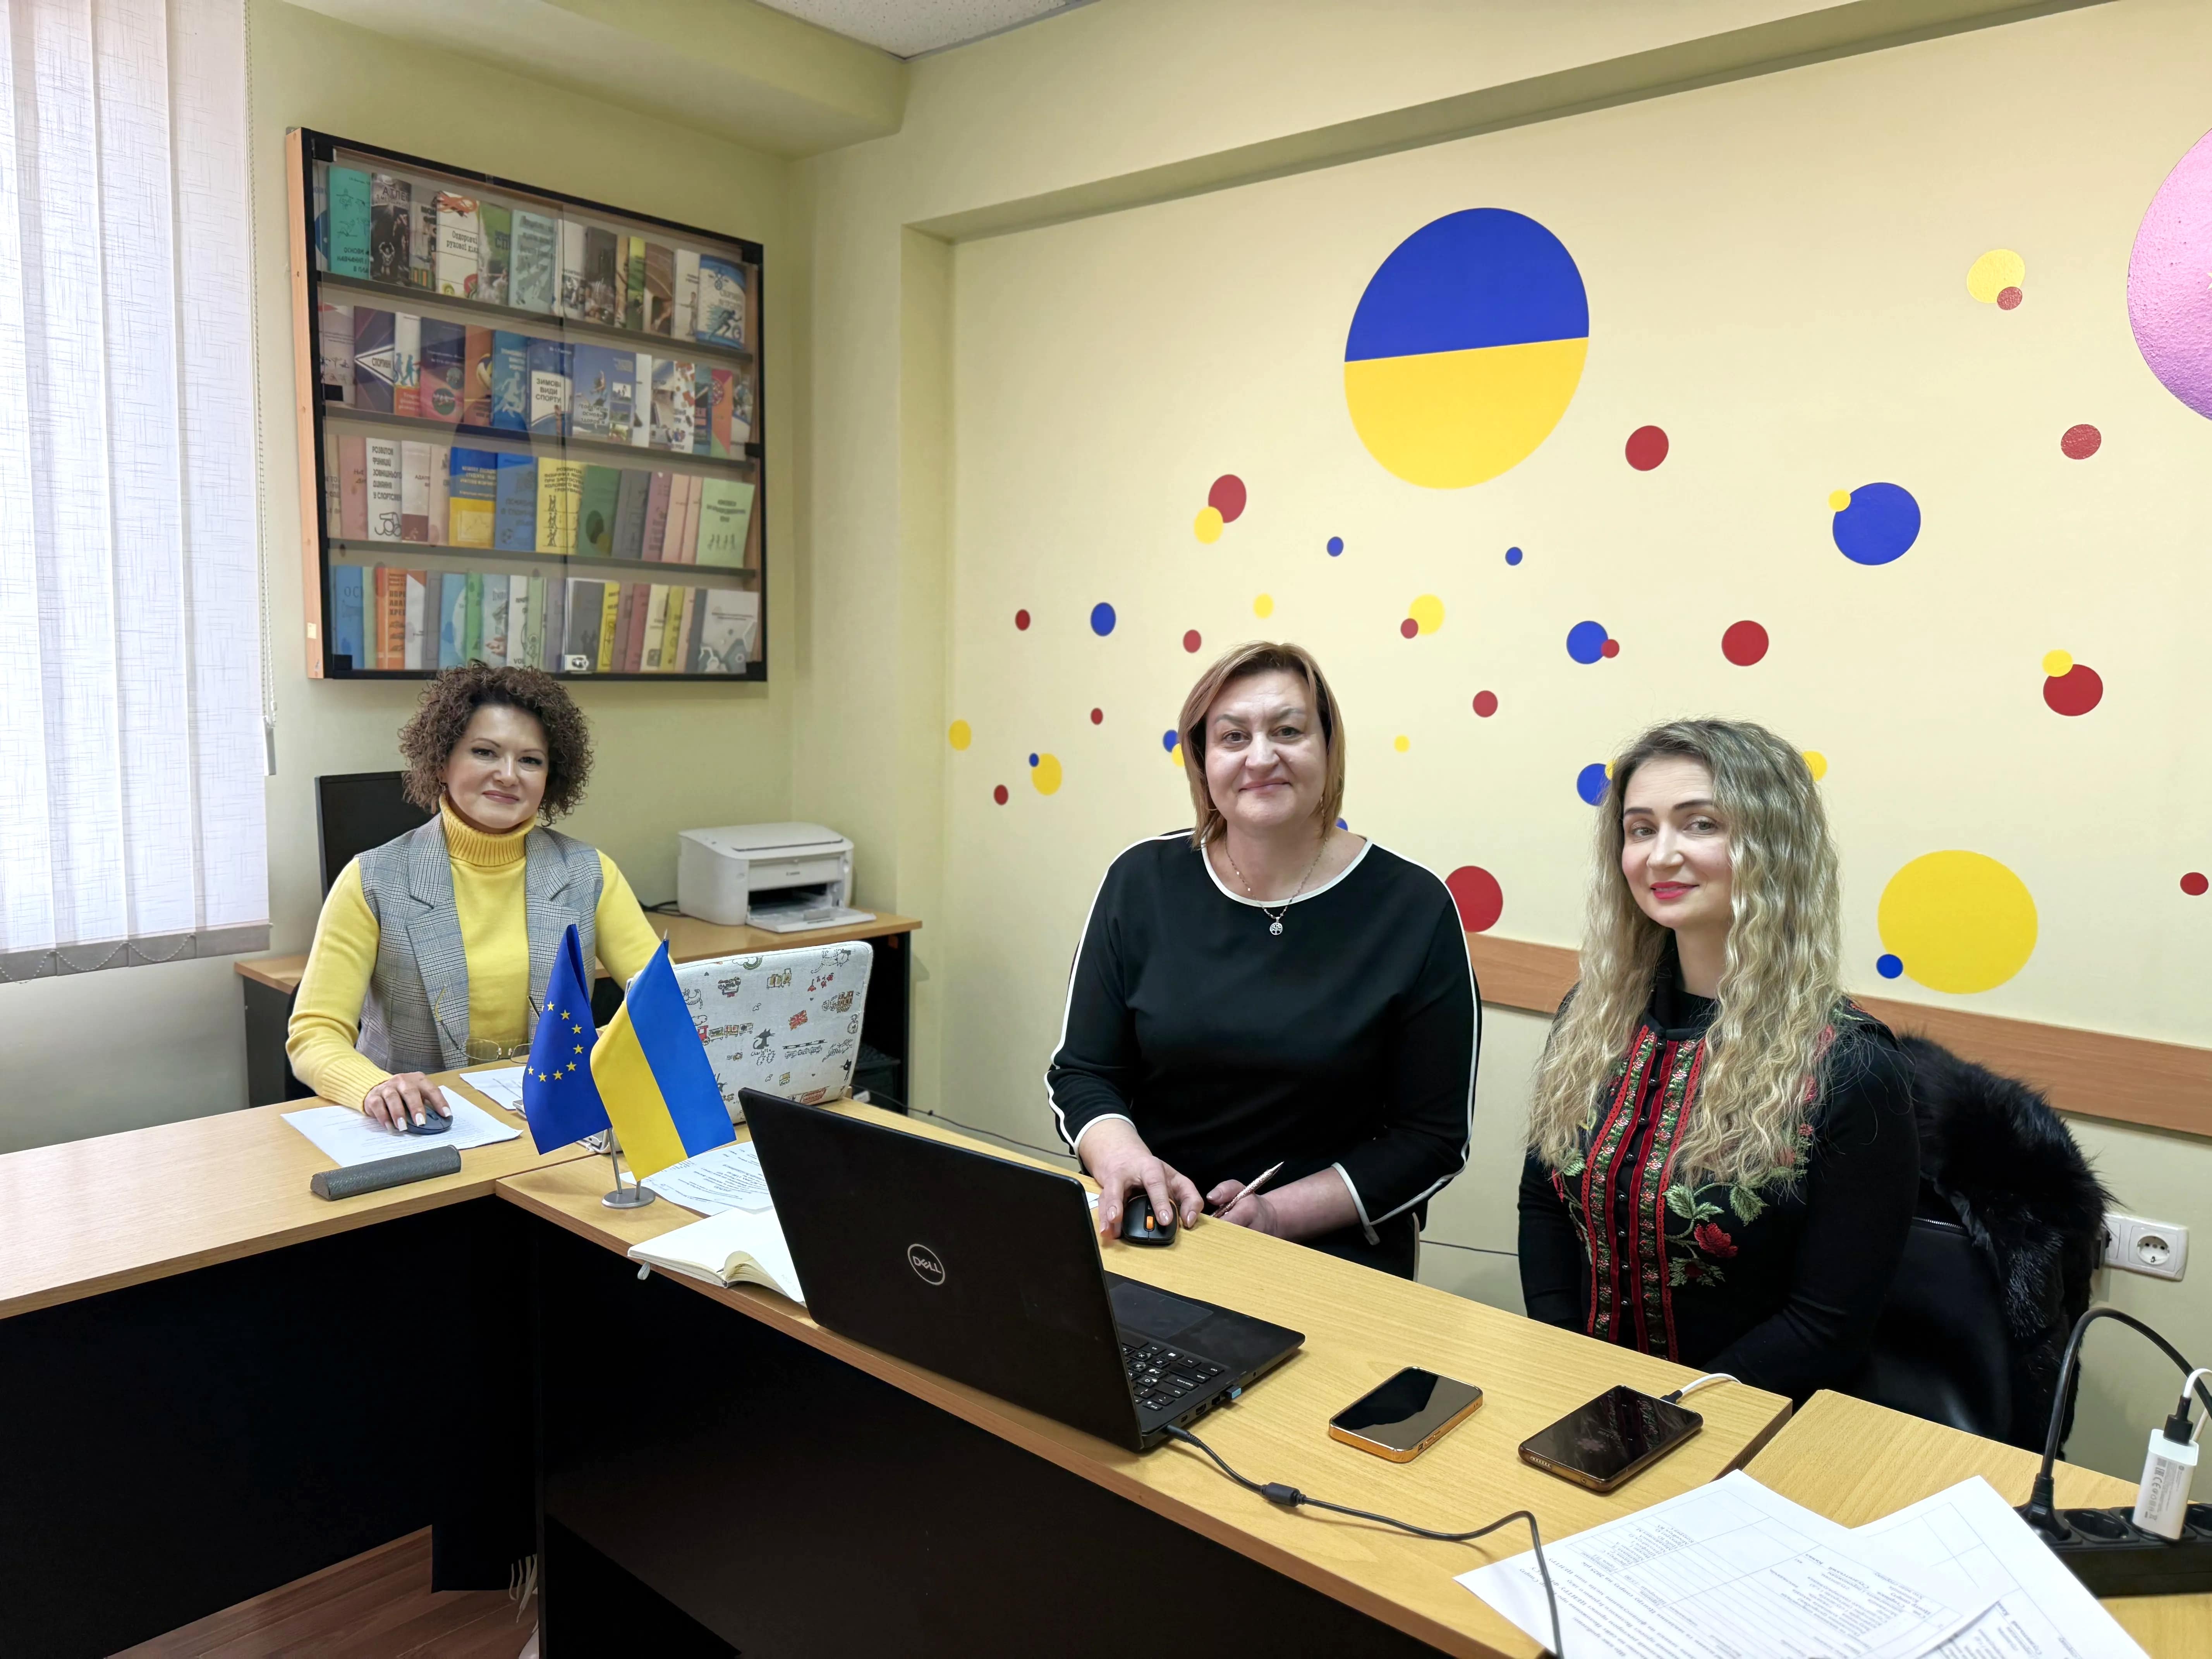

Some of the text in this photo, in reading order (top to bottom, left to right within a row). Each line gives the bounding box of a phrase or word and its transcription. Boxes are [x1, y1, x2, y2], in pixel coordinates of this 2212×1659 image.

[536, 378, 561, 387] ЗИМОВІ
[536, 394, 561, 403] СПОРТУ
[912, 1255, 942, 1274] DELL
[1547, 1558, 1573, 1574] ЦЕНТРУ
[1517, 1569, 1539, 1582] Спорту
[1827, 1566, 1870, 1589] Студентський
[1559, 1587, 1587, 1605] ЦЕНТРУ
[1613, 1583, 1633, 1596] спорту
[1632, 1597, 1656, 1613] Центру
